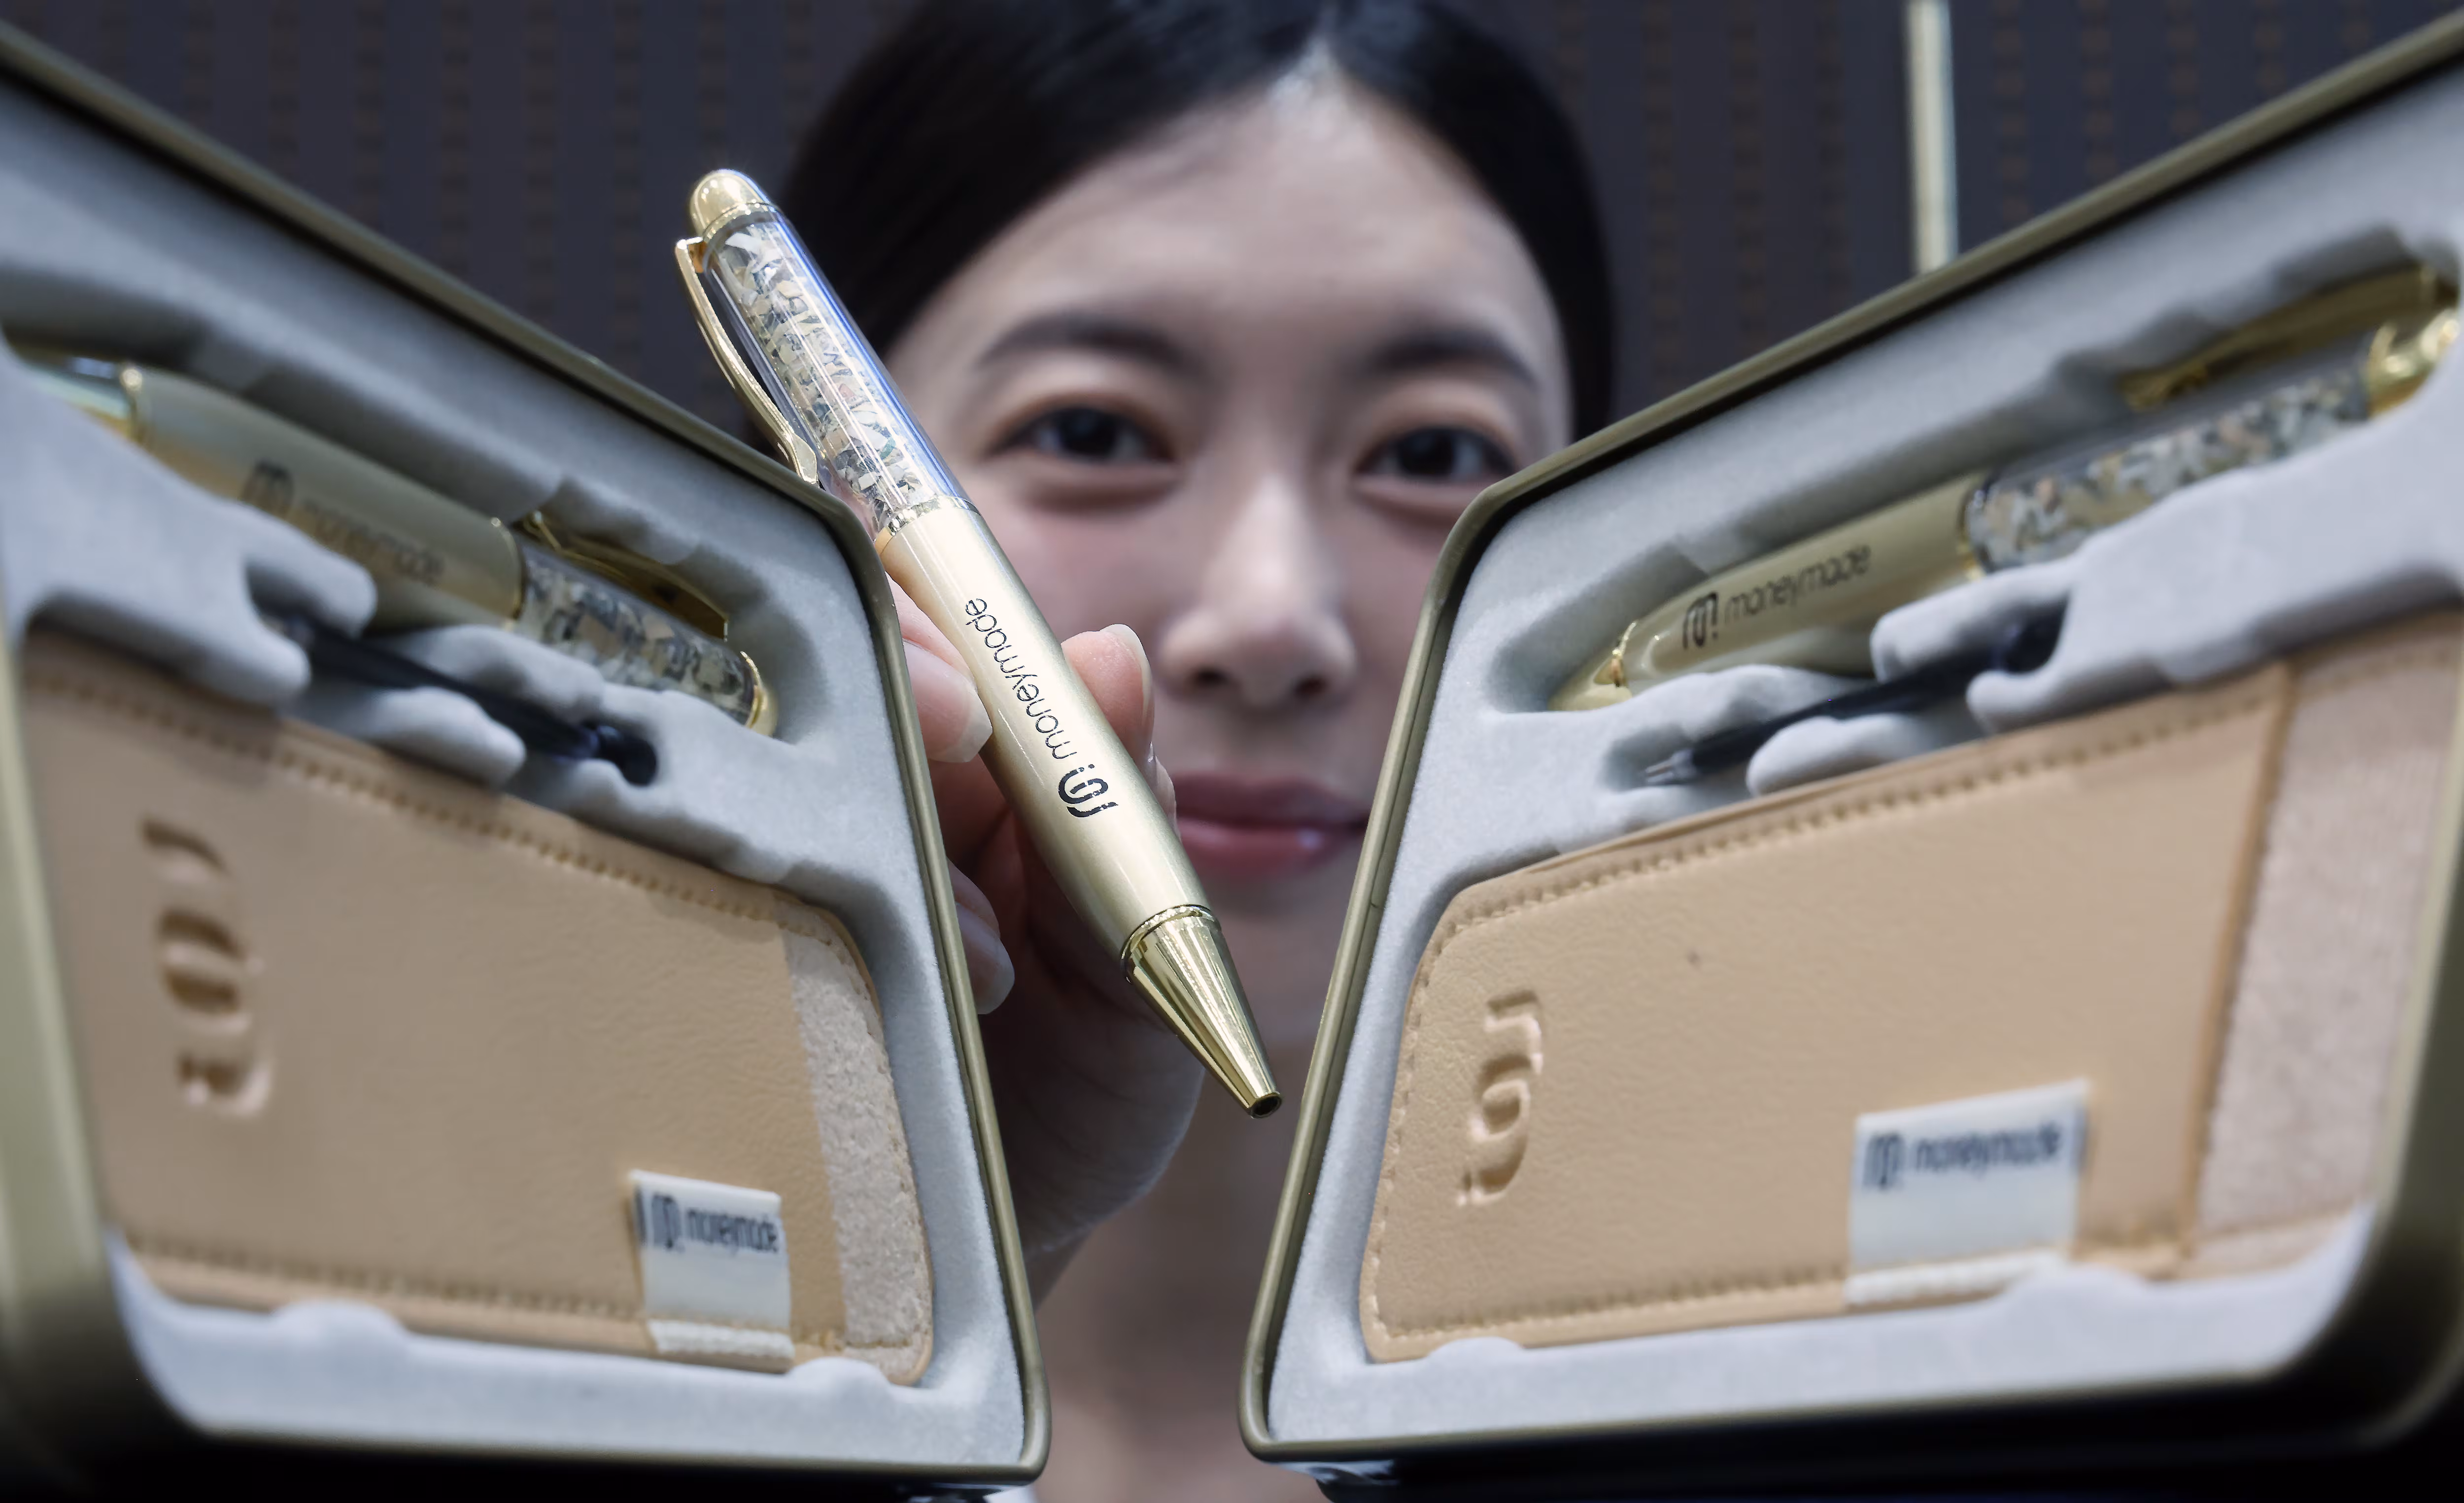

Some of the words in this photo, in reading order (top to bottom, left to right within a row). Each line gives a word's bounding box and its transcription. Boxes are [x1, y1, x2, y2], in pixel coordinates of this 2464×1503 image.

[1725, 545, 1872, 623] moneymade
[965, 598, 1077, 759] moneymade
[1916, 1120, 2062, 1181] moneymade
[686, 1207, 779, 1256] moneymade
